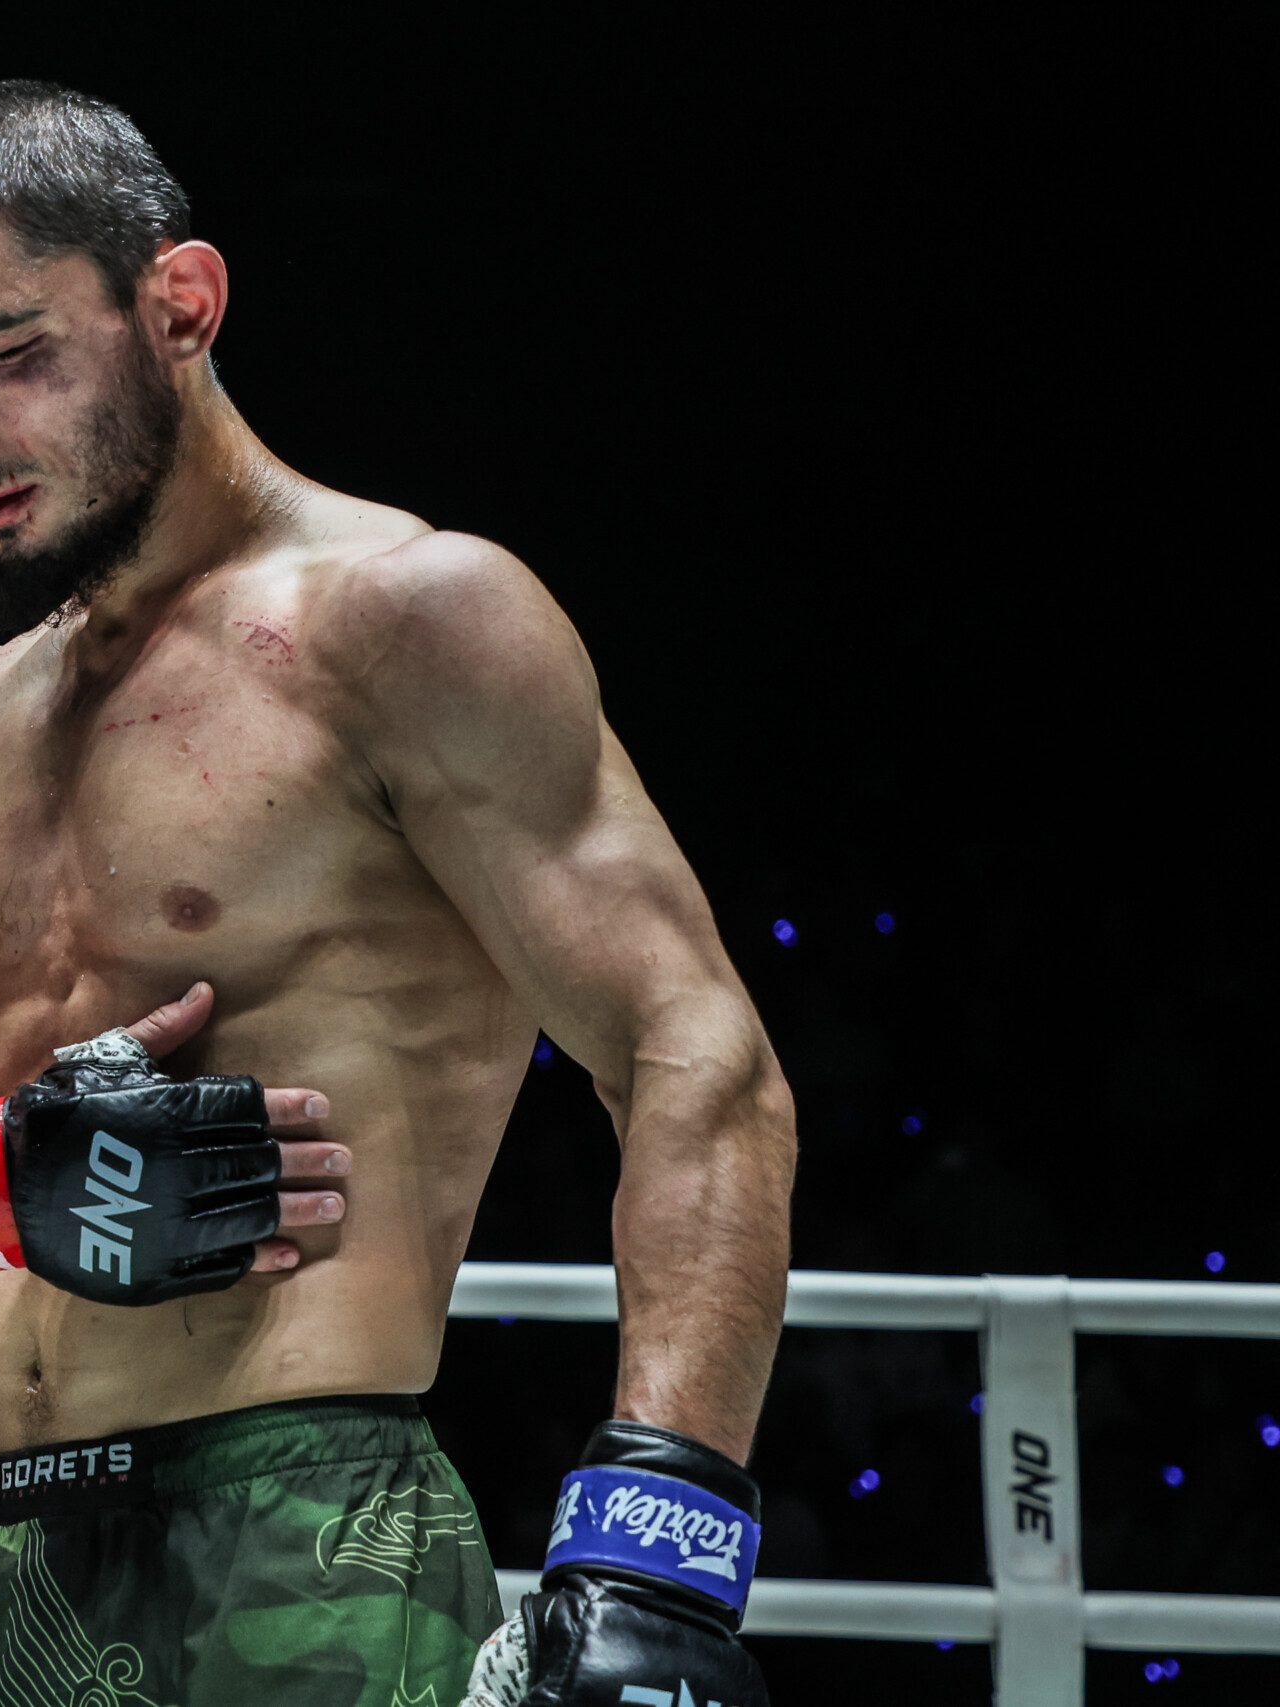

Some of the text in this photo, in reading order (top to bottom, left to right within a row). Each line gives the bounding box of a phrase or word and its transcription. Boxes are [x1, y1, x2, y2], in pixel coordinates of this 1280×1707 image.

[69, 1130, 153, 1286] ONE
[1, 1442, 133, 1490] GORETS
[1010, 1428, 1060, 1543] ONE
[601, 1485, 744, 1582] Fairtex
